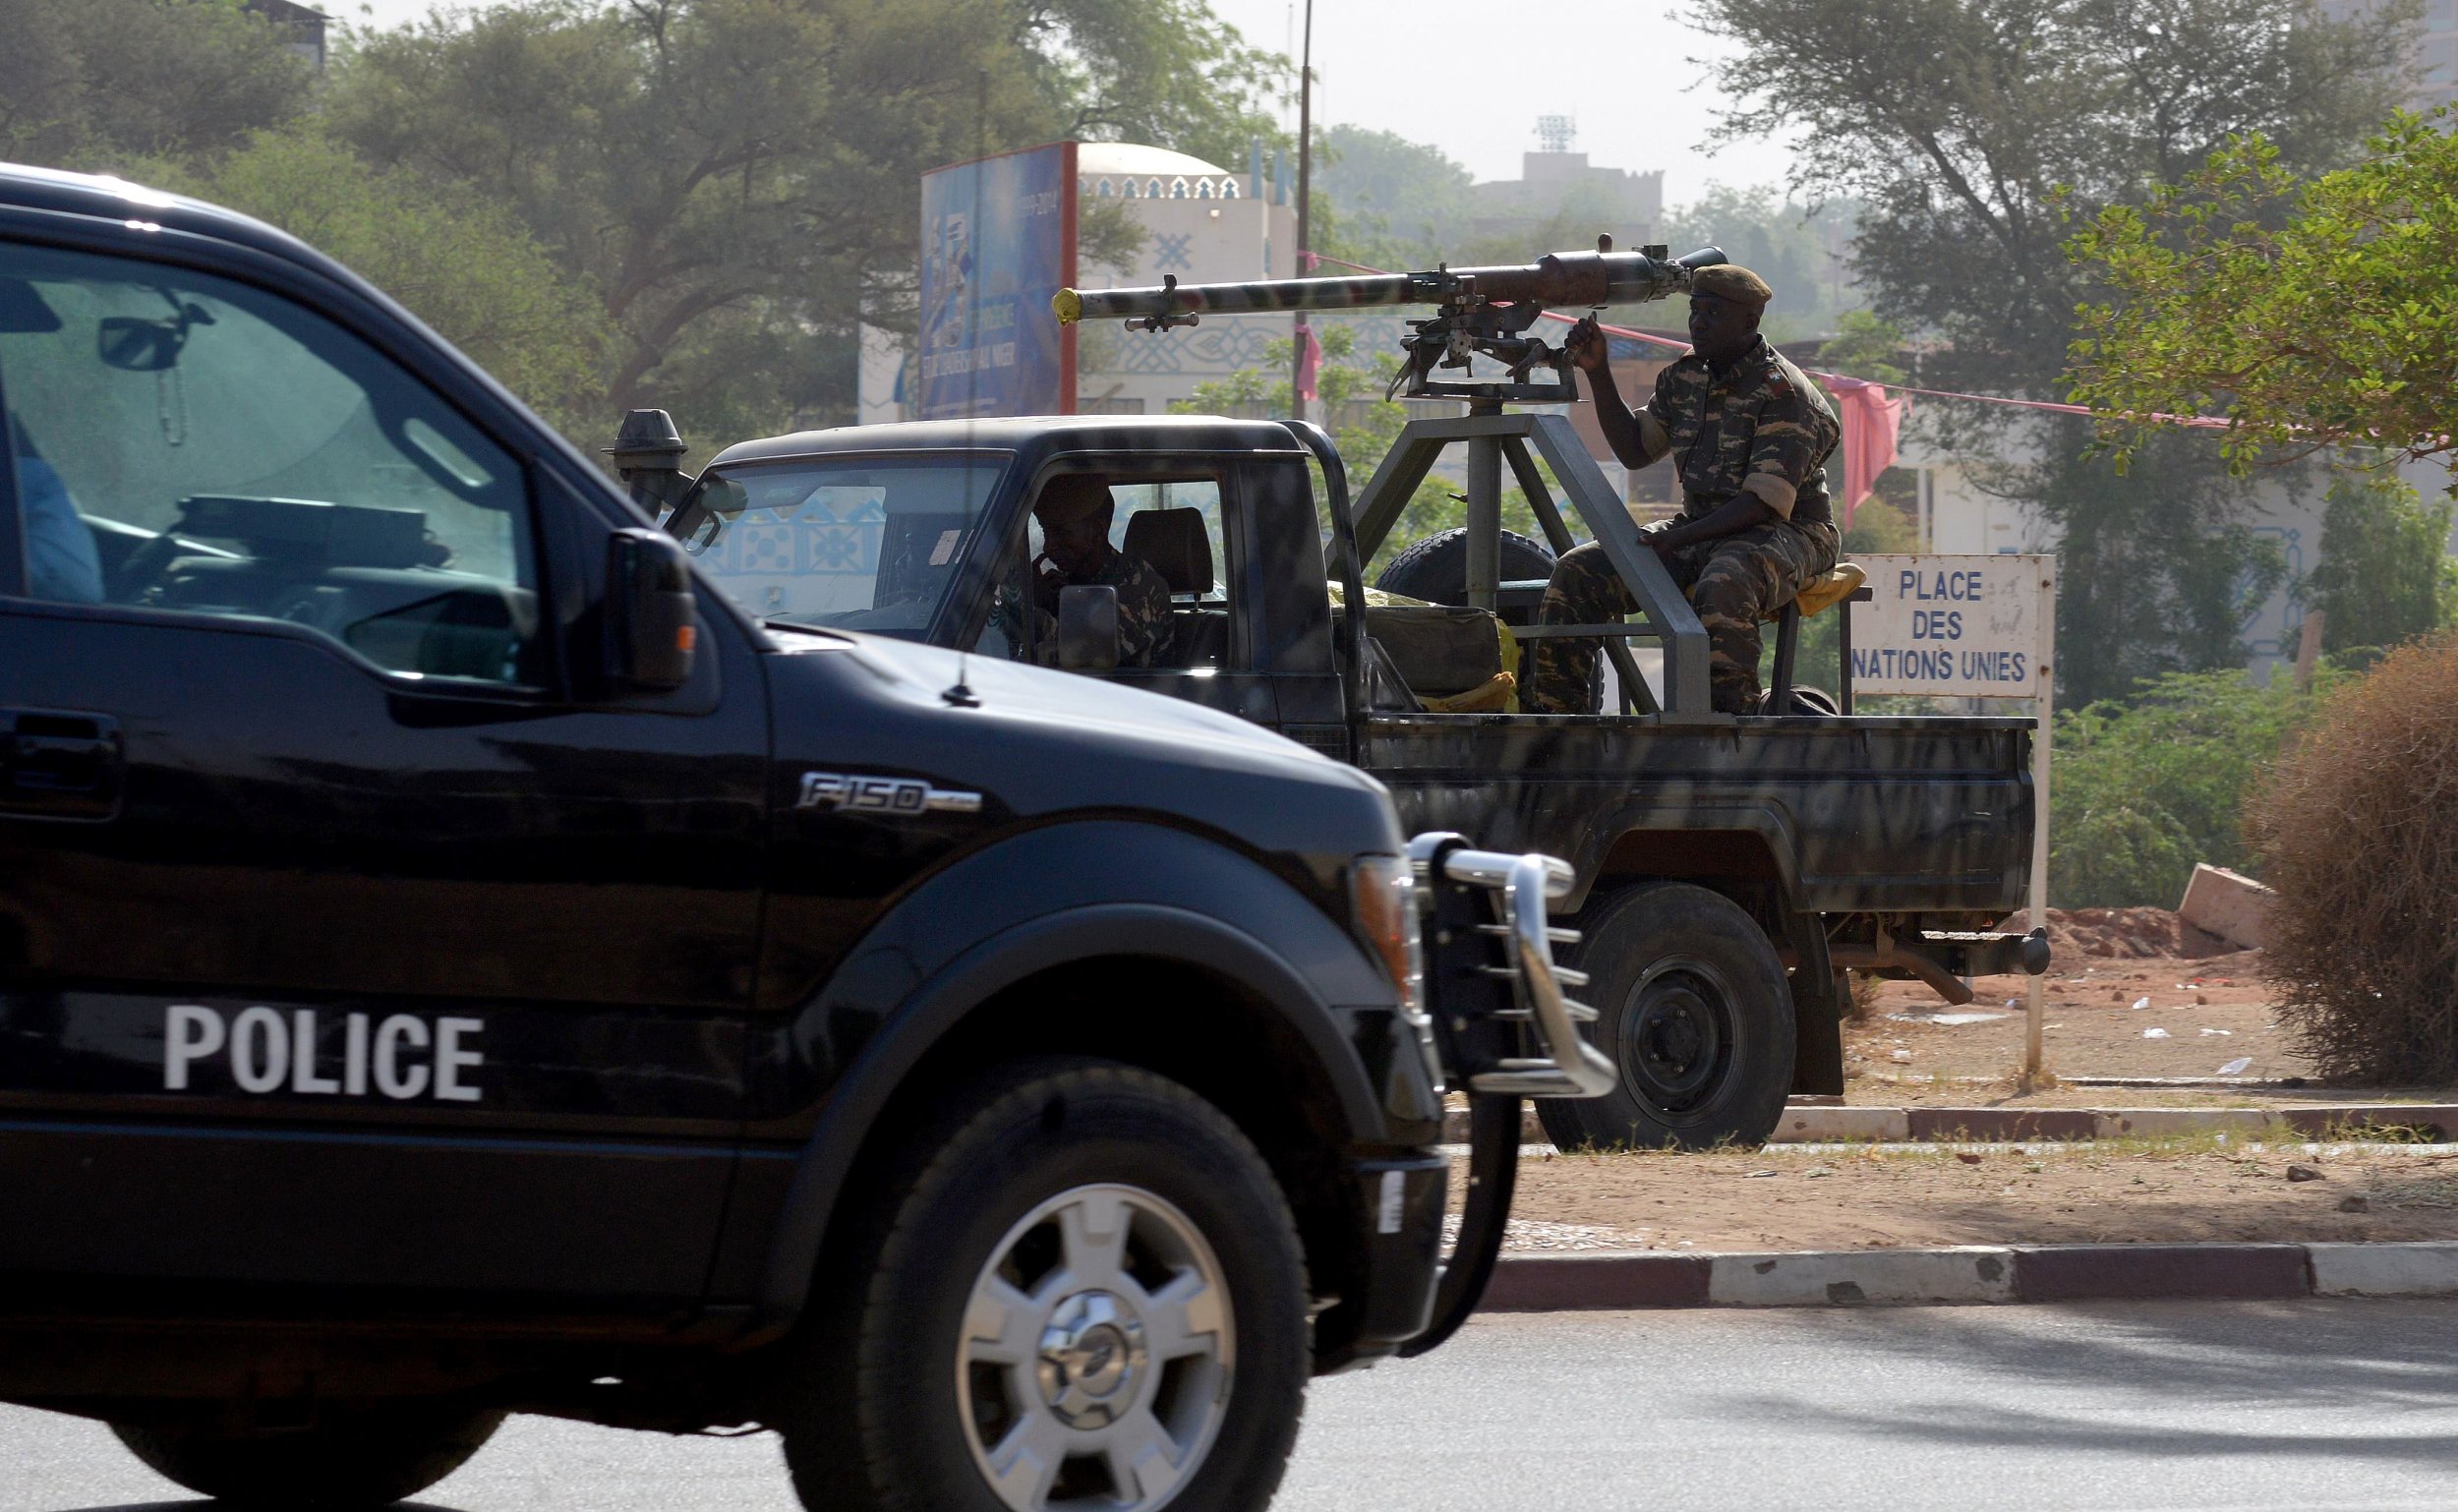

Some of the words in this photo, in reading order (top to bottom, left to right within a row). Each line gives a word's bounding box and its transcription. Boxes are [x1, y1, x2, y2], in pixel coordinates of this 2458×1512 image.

[1900, 570, 1982, 602] PLACE
[1912, 610, 1962, 640] DES
[1851, 648, 1954, 680] NATIONS
[1961, 650, 2025, 682] UNIES
[164, 1004, 484, 1102] POLICE
